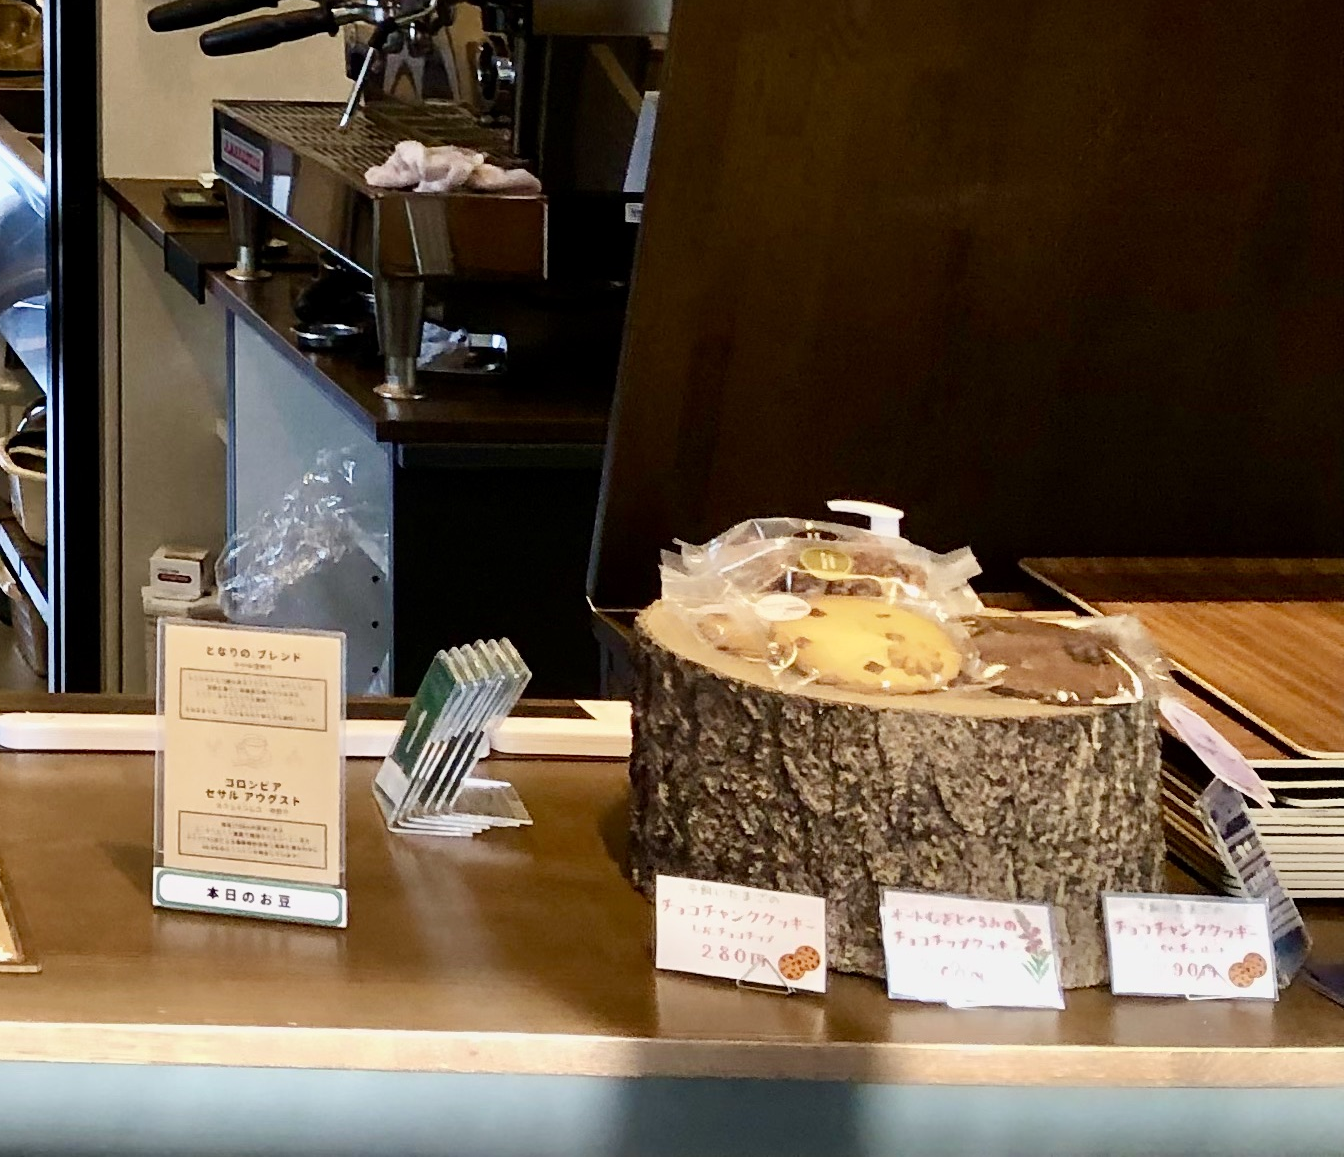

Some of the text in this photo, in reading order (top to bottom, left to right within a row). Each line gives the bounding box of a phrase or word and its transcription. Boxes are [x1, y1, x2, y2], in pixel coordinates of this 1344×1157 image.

[206, 646, 251, 659] となりの
[206, 886, 291, 909] 本日のお豆
